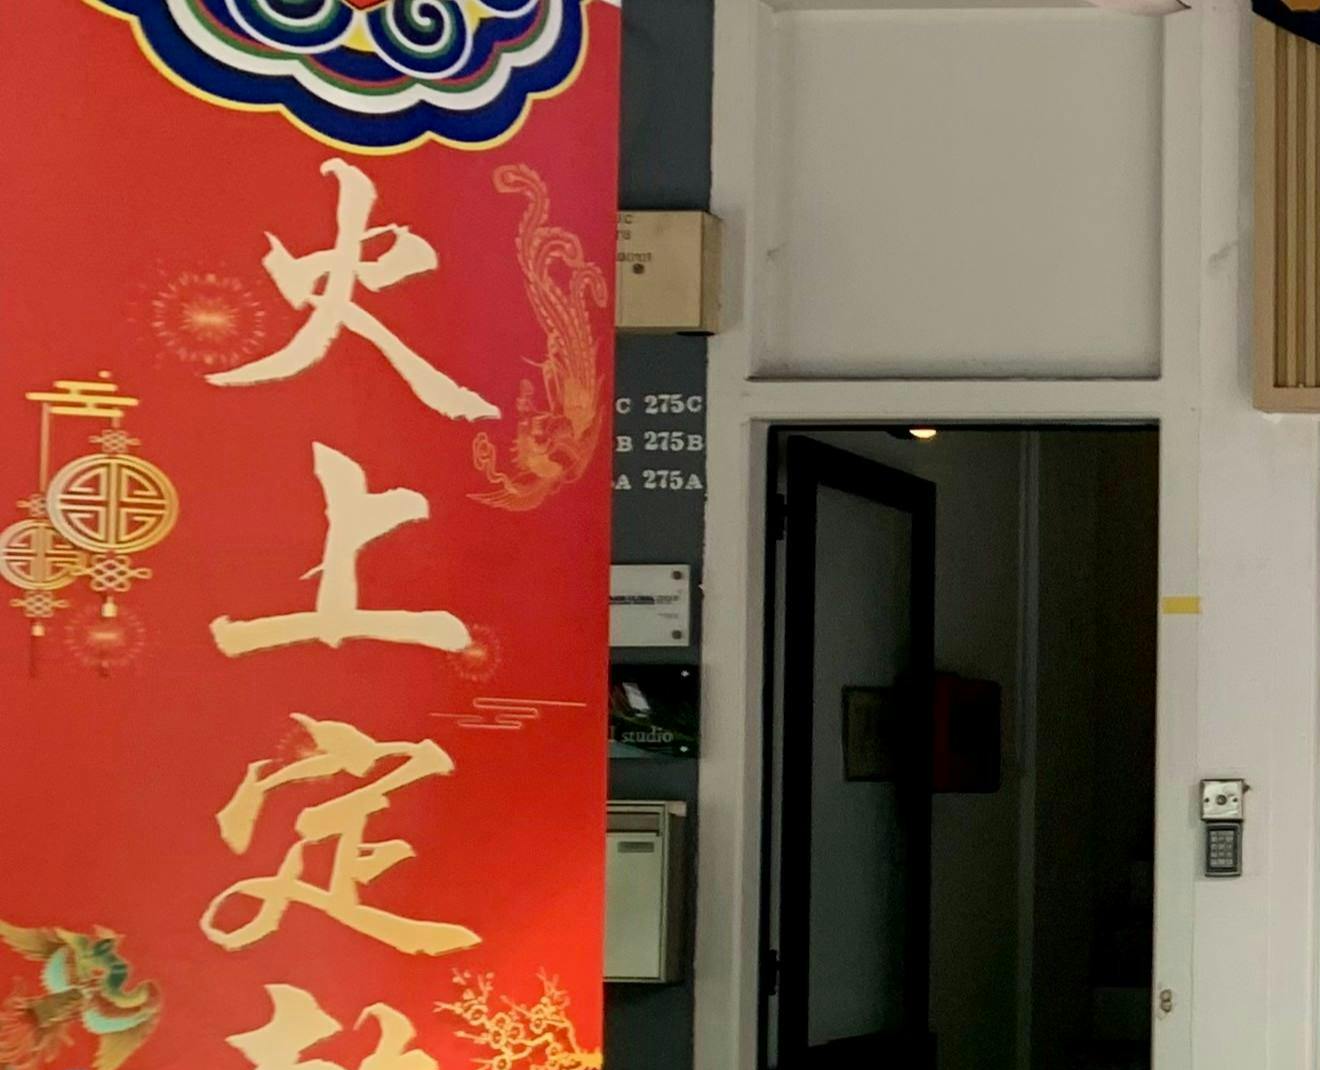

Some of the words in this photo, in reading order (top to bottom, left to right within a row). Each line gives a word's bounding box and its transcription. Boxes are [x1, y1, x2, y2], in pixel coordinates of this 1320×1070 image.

[644, 393, 703, 414] 275C
[643, 430, 704, 452] 275B
[642, 469, 703, 490] 275A
[621, 726, 675, 744] studio
